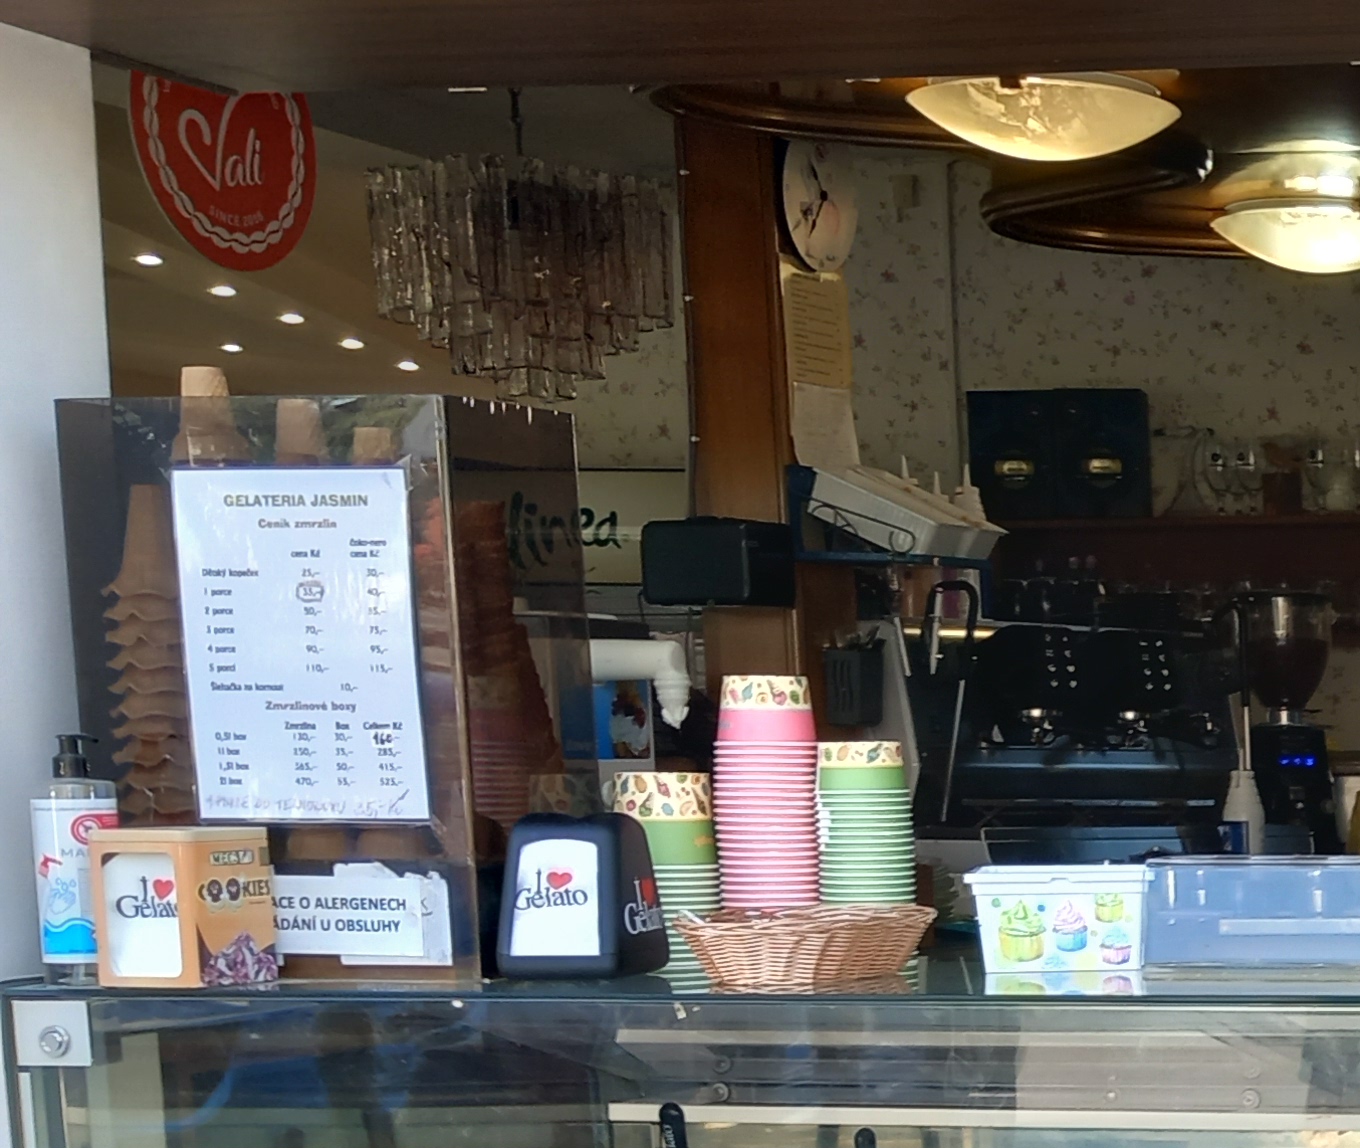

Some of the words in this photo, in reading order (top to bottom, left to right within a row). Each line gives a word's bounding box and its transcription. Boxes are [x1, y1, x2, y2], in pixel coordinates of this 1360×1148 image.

[178, 92, 262, 191] Vali
[223, 494, 307, 507] GELATERIA
[310, 494, 369, 507] JASMIN
[294, 518, 337, 529] zmrzlin
[210, 588, 232, 598] porce
[212, 607, 234, 617] porce
[213, 626, 235, 636] porce
[215, 645, 236, 655] porce
[265, 700, 328, 711] Zmrzlinové
[331, 701, 357, 713] boxy
[232, 732, 247, 741] box
[226, 747, 240, 756] box
[235, 762, 250, 771] box
[226, 777, 242, 785] box
[535, 868, 542, 895] I
[139, 876, 152, 901] I
[271, 896, 295, 909] ACE
[299, 897, 311, 909] O
[315, 897, 406, 911] ALERGENECH
[514, 888, 588, 911] Gelato
[273, 914, 317, 931] ÁDÁNÍ
[320, 919, 331, 931] U
[335, 919, 401, 933] OBSLUHY
